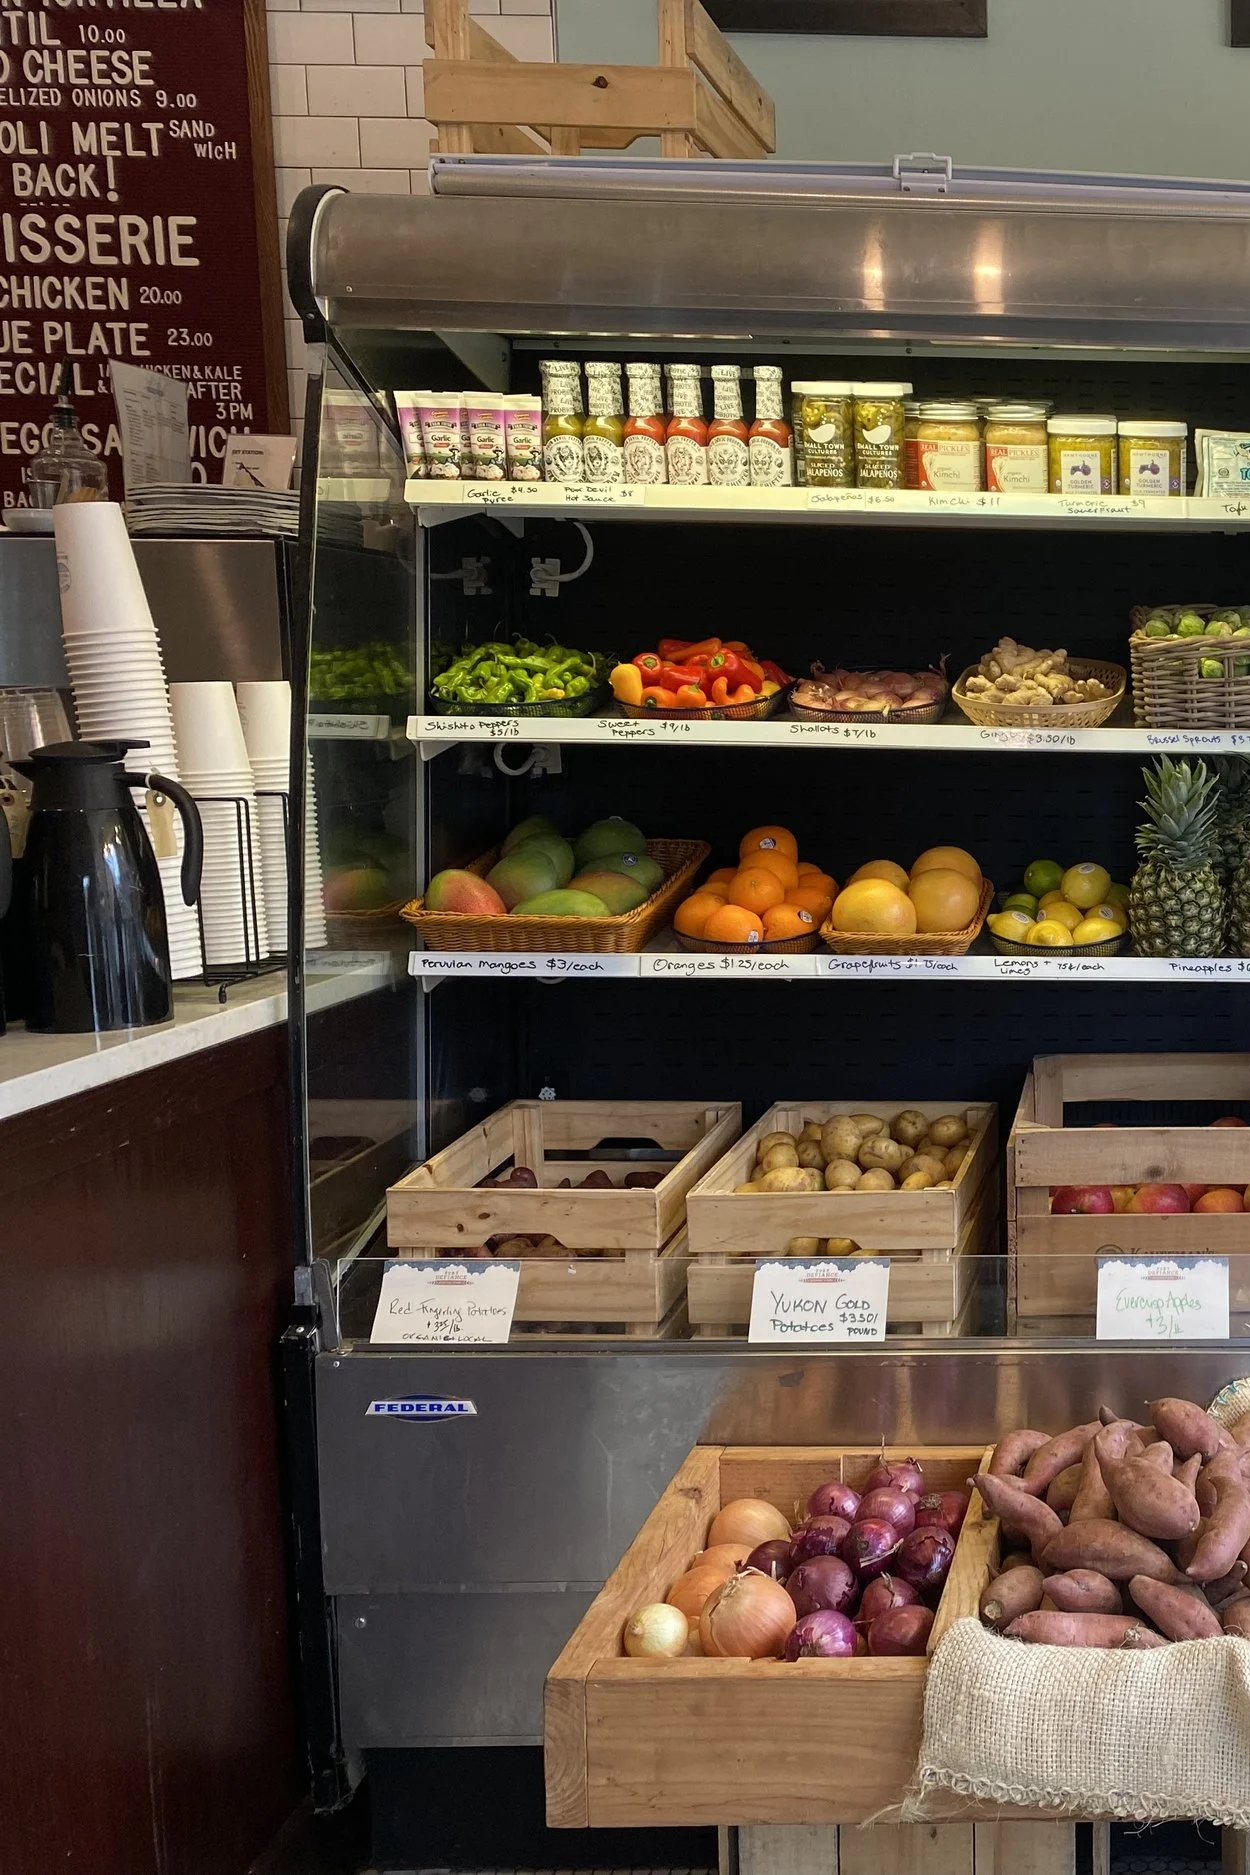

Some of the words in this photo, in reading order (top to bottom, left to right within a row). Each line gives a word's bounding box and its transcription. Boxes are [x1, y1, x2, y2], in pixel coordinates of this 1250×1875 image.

[78, 24, 126, 44] 10.00
[22, 49, 154, 85] CHEESE
[71, 89, 142, 108] ONIONS
[155, 90, 197, 108] 9.00
[71, 121, 164, 156] MELT
[12, 155, 119, 202] BACK!
[2, 212, 200, 267] ISSERIE
[139, 286, 182, 304] 20.00
[43, 321, 151, 356] PLATE
[167, 328, 213, 347] 23.00
[186, 382, 242, 399] AFTER
[431, 434, 451, 442] Garlic
[477, 436, 495, 444] Garlic
[934, 471, 960, 479] Kimchi
[467, 489, 501, 498] Garlic
[1058, 499, 1109, 507] Turmeric
[1222, 502, 1248, 516] Tofu
[425, 721, 475, 731] Shishito
[479, 720, 519, 728] Peppers
[597, 720, 639, 728] Sweet
[790, 725, 839, 734] Shallots
[843, 728, 876, 738] $7/lb
[421, 959, 473, 968] Peruvian
[546, 958, 604, 971] $3/each
[653, 958, 715, 976] Oranges
[828, 958, 901, 973] Grapefruits
[994, 959, 1038, 968] Lemons
[1169, 963, 1232, 975] Pineapples
[389, 1298, 415, 1315] Red
[467, 1301, 507, 1317] Potatoes
[1167, 1290, 1202, 1316] Apples
[770, 1318, 834, 1333] Potatoes
[847, 1327, 878, 1337] POUND
[374, 1403, 469, 1412] FEDERAL
